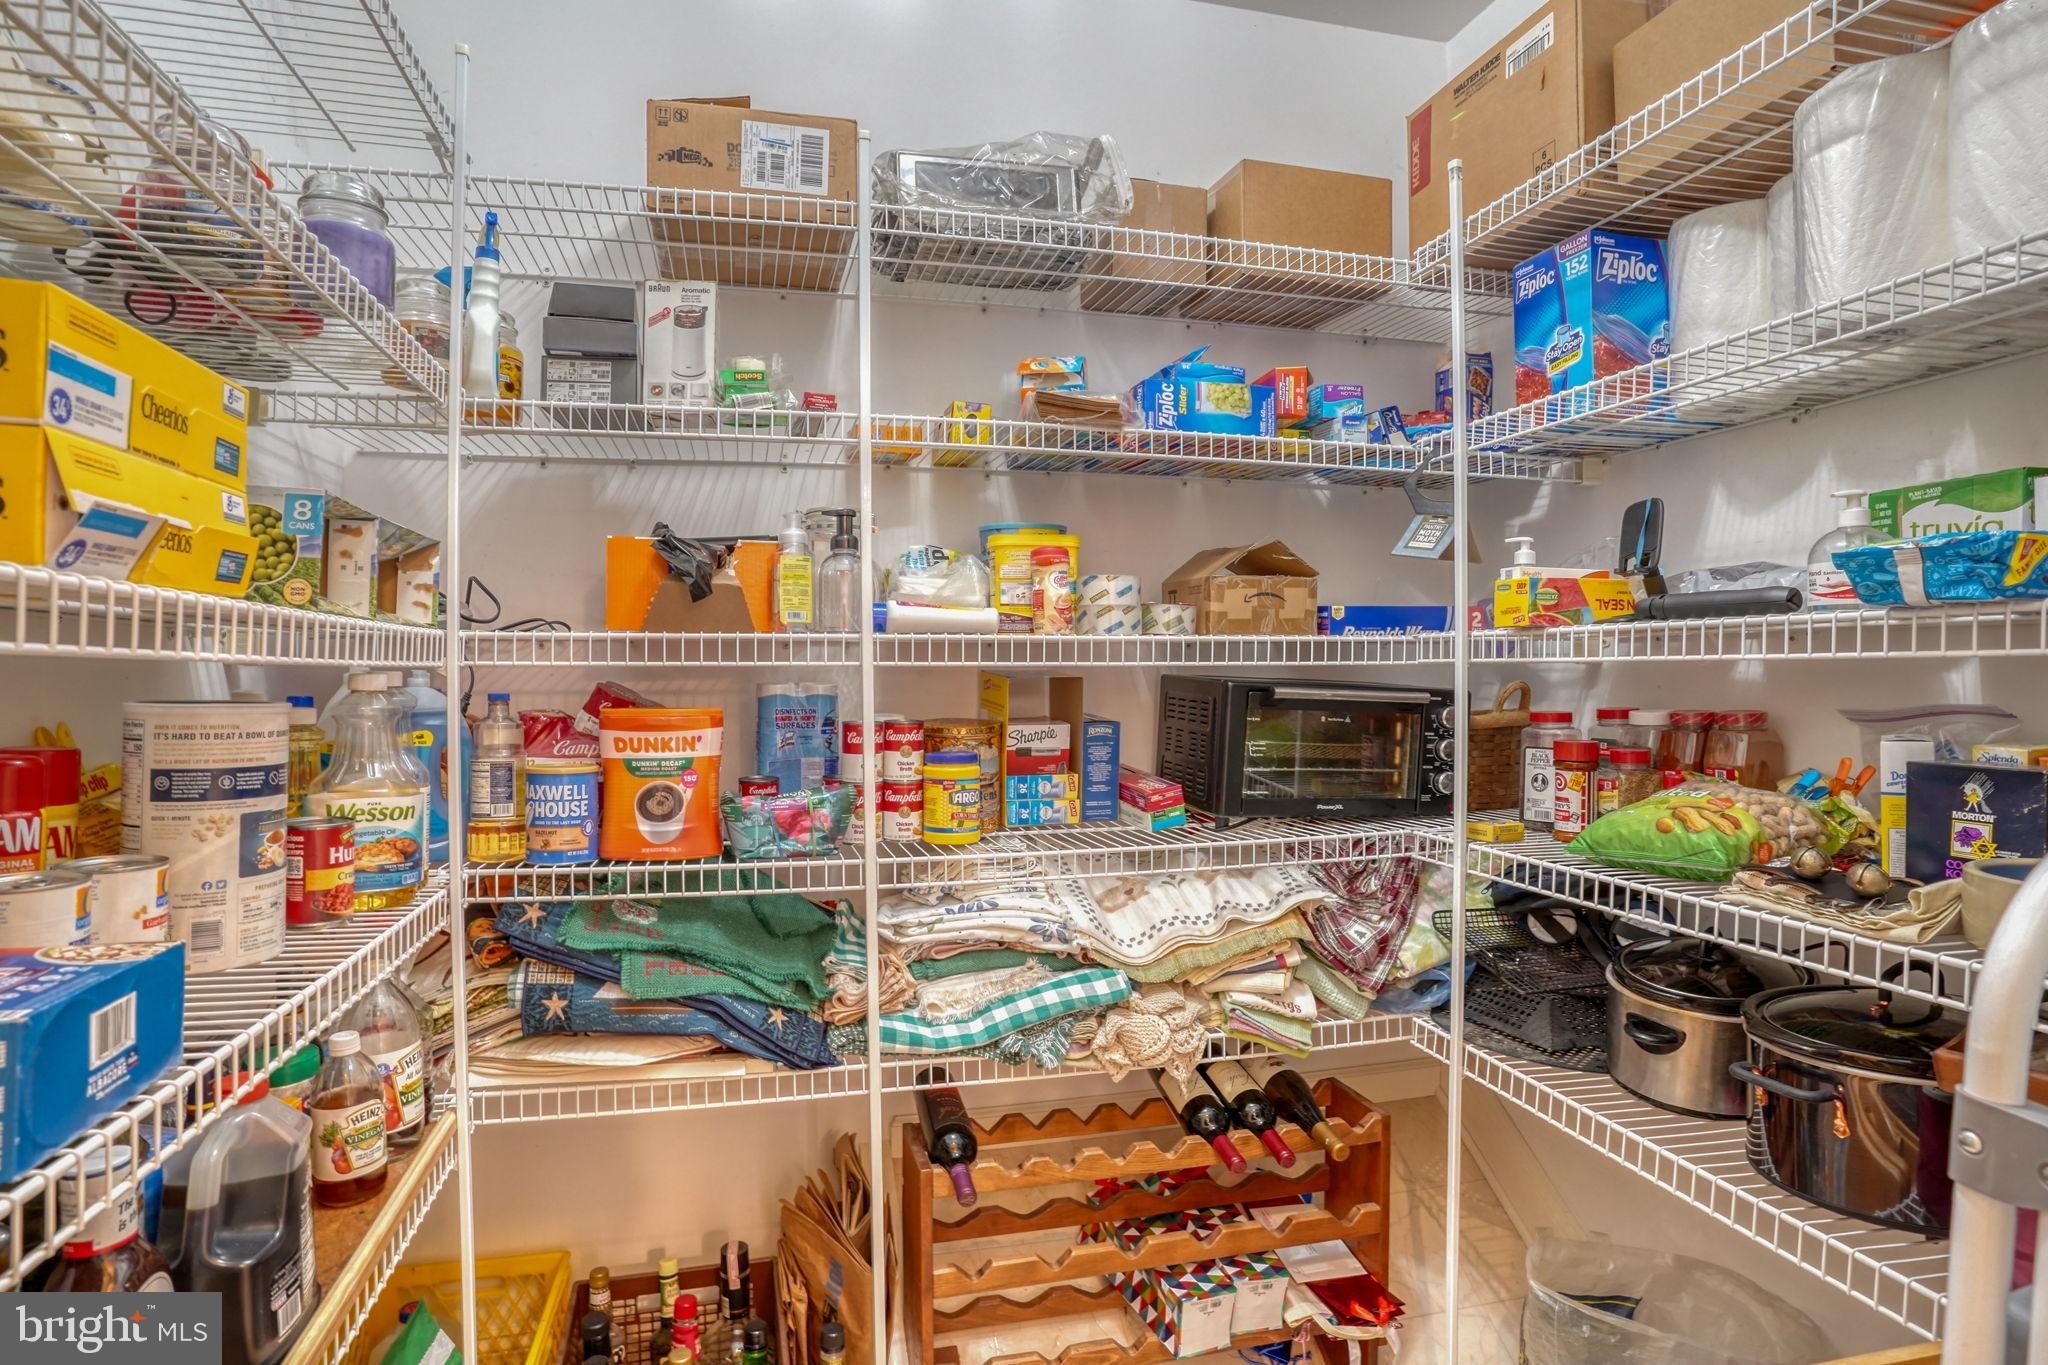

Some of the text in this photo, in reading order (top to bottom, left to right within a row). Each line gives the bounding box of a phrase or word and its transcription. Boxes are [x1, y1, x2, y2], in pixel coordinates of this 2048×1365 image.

[1454, 69, 1479, 96] WALTER
[1480, 53, 1501, 76] KIDDE
[1412, 137, 1420, 188] KIDDE
[1541, 150, 1547, 160] 6
[1560, 235, 1588, 253] GALLON
[1565, 254, 1588, 276] 152
[1602, 252, 1658, 284] Ziploc
[1518, 270, 1555, 299] Ziploc
[1547, 337, 1582, 362] Stay Open
[1650, 344, 1670, 354] Stay
[1158, 383, 1178, 427] Ziploc
[1178, 384, 1188, 415] Slider
[142, 393, 188, 435] Cheerios
[294, 500, 312, 520] 8
[288, 522, 315, 530] CANS
[1595, 598, 1624, 610] SEAL
[1472, 611, 1482, 627] 2
[154, 732, 169, 741] IT'S
[171, 732, 196, 740] HARD
[199, 732, 211, 740] TO
[213, 732, 235, 740] BEAT
[245, 731, 266, 740] BOWL
[267, 730, 275, 738] OF
[1007, 726, 1058, 748] Sharpie
[1088, 726, 1113, 736] RONZONI
[614, 736, 702, 753] DUNKIN'
[1977, 752, 2019, 764] Splenda
[88, 774, 109, 792] clip
[1020, 783, 1028, 794] 26
[953, 791, 980, 804] ARGO
[325, 803, 416, 823] Wesson
[535, 800, 588, 818] HOUSE
[1020, 808, 1029, 819] 26
[1952, 810, 1995, 822] MORTON
[48, 824, 78, 858] AM
[354, 828, 386, 840] egetable
[0, 858, 34, 868] GINAL
[1945, 860, 1963, 868] CO
[1946, 869, 1963, 878] KO
[350, 1106, 381, 1126] HEINZ
